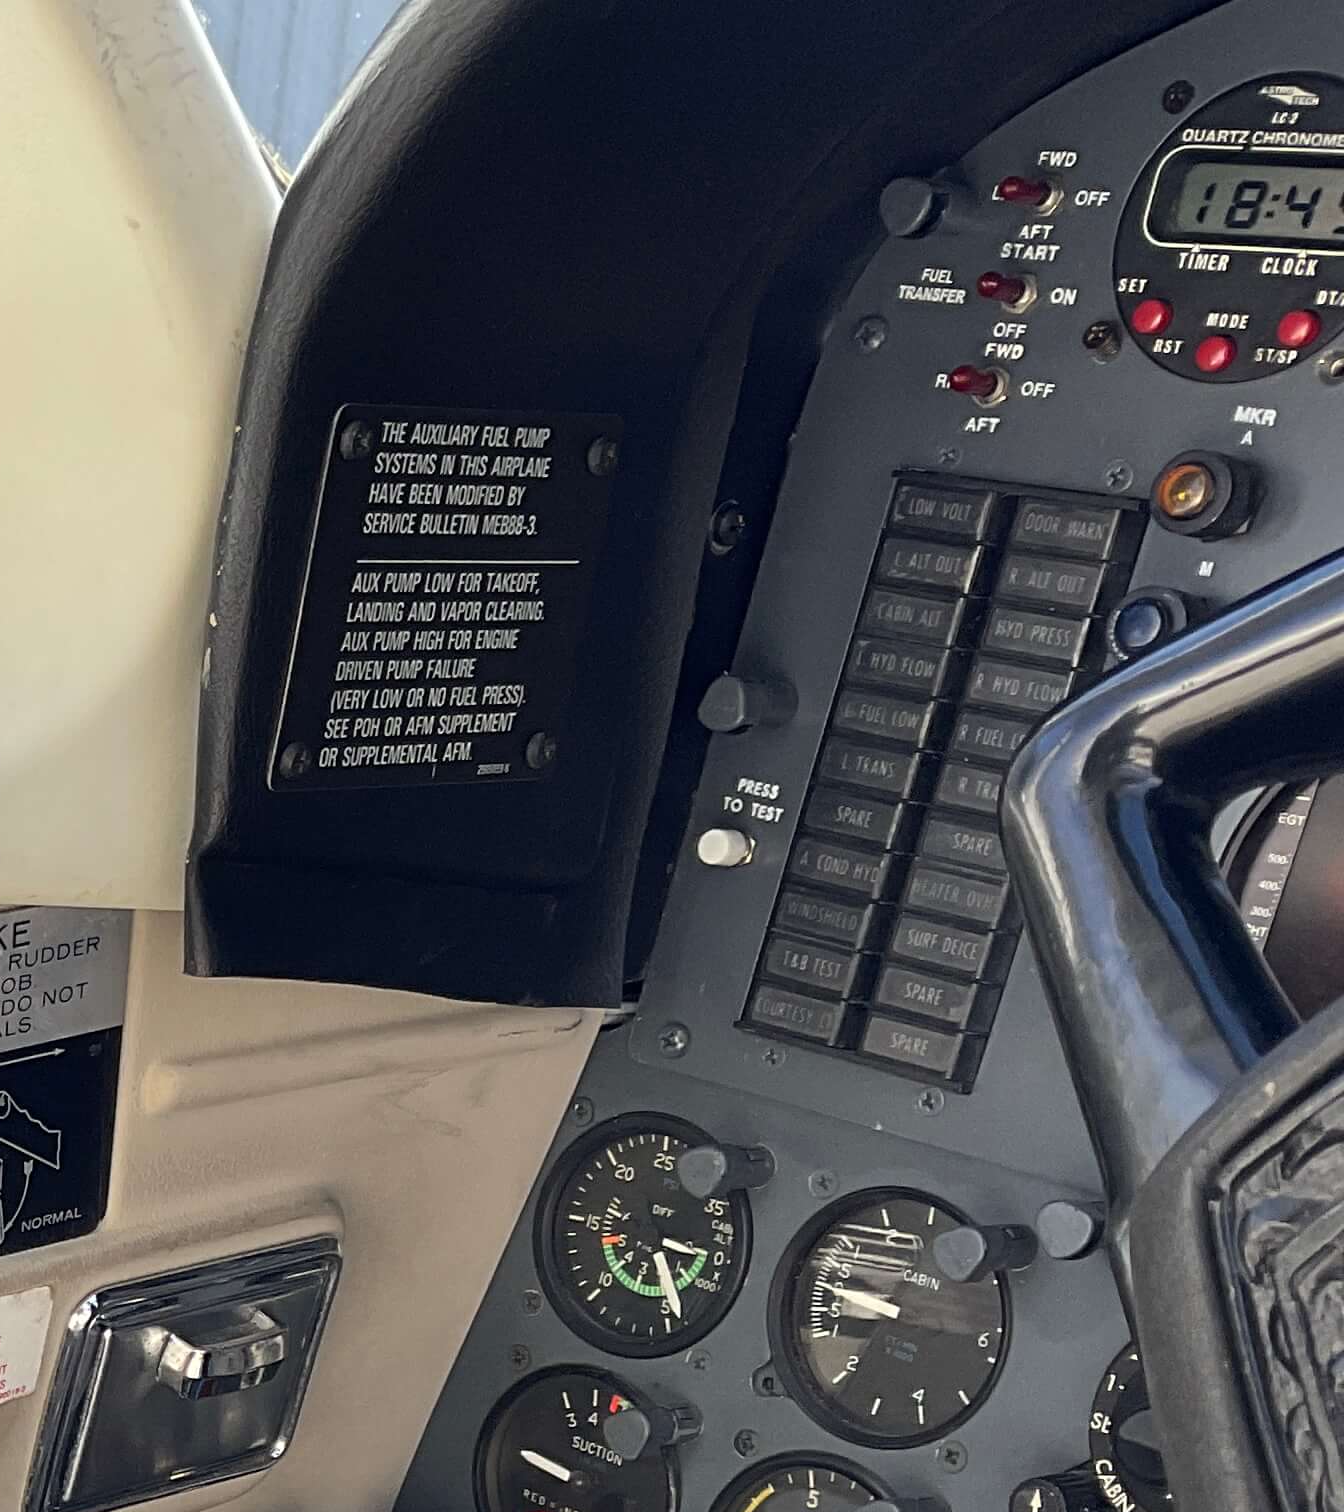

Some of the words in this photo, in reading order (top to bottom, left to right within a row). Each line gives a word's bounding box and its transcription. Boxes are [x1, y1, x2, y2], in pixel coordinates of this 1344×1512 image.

[1182, 129, 1249, 143] QUARTZ
[1252, 131, 1344, 147] CHRONOME
[1038, 151, 1077, 167] FWD
[1075, 191, 1110, 206] OFF
[1196, 180, 1344, 234] 18:4
[1019, 225, 1053, 240] AFT
[1001, 244, 1060, 261] START
[1178, 253, 1230, 271] TIMER
[921, 268, 953, 284] FUEL
[1261, 257, 1319, 276] CLOCK
[898, 285, 965, 304] TRANSFER
[1118, 278, 1147, 293] SET
[1051, 289, 1077, 304] ON
[993, 323, 1026, 338] OFF
[1207, 313, 1249, 330] MODE
[984, 344, 1024, 360] FWD
[1153, 339, 1182, 355] RST
[1254, 348, 1297, 364] ST/SP
[1020, 382, 1055, 398] OFF
[965, 417, 1000, 433] AFT
[1233, 406, 1277, 426] MKR
[381, 422, 407, 444] THE
[411, 424, 478, 446] AUXILIARY
[481, 427, 510, 447] FUEL
[515, 428, 551, 448] PUMP
[375, 454, 436, 474] SYSTEMS
[440, 456, 454, 474] IN
[459, 456, 487, 476] THIS
[491, 457, 552, 477] AIRPLANE
[369, 486, 405, 504] HAVE
[409, 486, 442, 504] BEEN
[446, 486, 504, 505] MODIFIED
[507, 487, 525, 506] BY
[364, 514, 416, 534] SERVICE
[420, 515, 477, 534] BULLETIN
[352, 574, 380, 593] AUX
[384, 573, 421, 593] PUMP
[425, 574, 455, 592] LOW
[458, 573, 484, 592] FOR
[487, 573, 540, 596] TAKEOFF,
[347, 602, 403, 622] LANDING
[408, 602, 437, 622] AND
[440, 602, 481, 621] VAPOR
[485, 601, 544, 621] CLEARING.
[341, 632, 368, 651] AUX
[373, 631, 410, 651] PUMP
[413, 631, 444, 650] HIGH
[447, 630, 473, 649] FOR
[475, 630, 519, 649] ENGINE
[335, 661, 382, 681] DRIVEN
[386, 660, 423, 680] PUMP
[426, 659, 476, 678] FAILURE
[330, 690, 369, 713] (VERY
[372, 689, 403, 709] LOW
[407, 688, 425, 707] OR
[428, 688, 446, 706] NO
[449, 687, 478, 705] FUEL
[482, 685, 526, 706] PRESS).
[325, 719, 350, 739] SEE
[353, 718, 380, 738] POH
[384, 717, 402, 736] OR
[405, 716, 434, 736] AFM
[438, 713, 515, 734] SUPPLEMENT
[320, 747, 338, 767] OR
[342, 744, 437, 766] SUPPLEMENTAL
[443, 743, 472, 762] AFM.
[737, 778, 780, 799] PRESS
[723, 797, 743, 813] TO
[751, 803, 784, 823] TEST
[834, 805, 873, 829] SPARE
[8, 936, 102, 970] RUDDER
[1, 995, 33, 1016] DO
[41, 982, 89, 1006] NOT
[889, 1031, 928, 1057] SPARE
[654, 1153, 675, 1171] 25
[615, 1165, 635, 1181] 20
[20, 1206, 82, 1233] NORMAL
[587, 1214, 600, 1231] 15
[903, 1269, 939, 1290] CABIN
[572, 1436, 623, 1466] SUCTION
